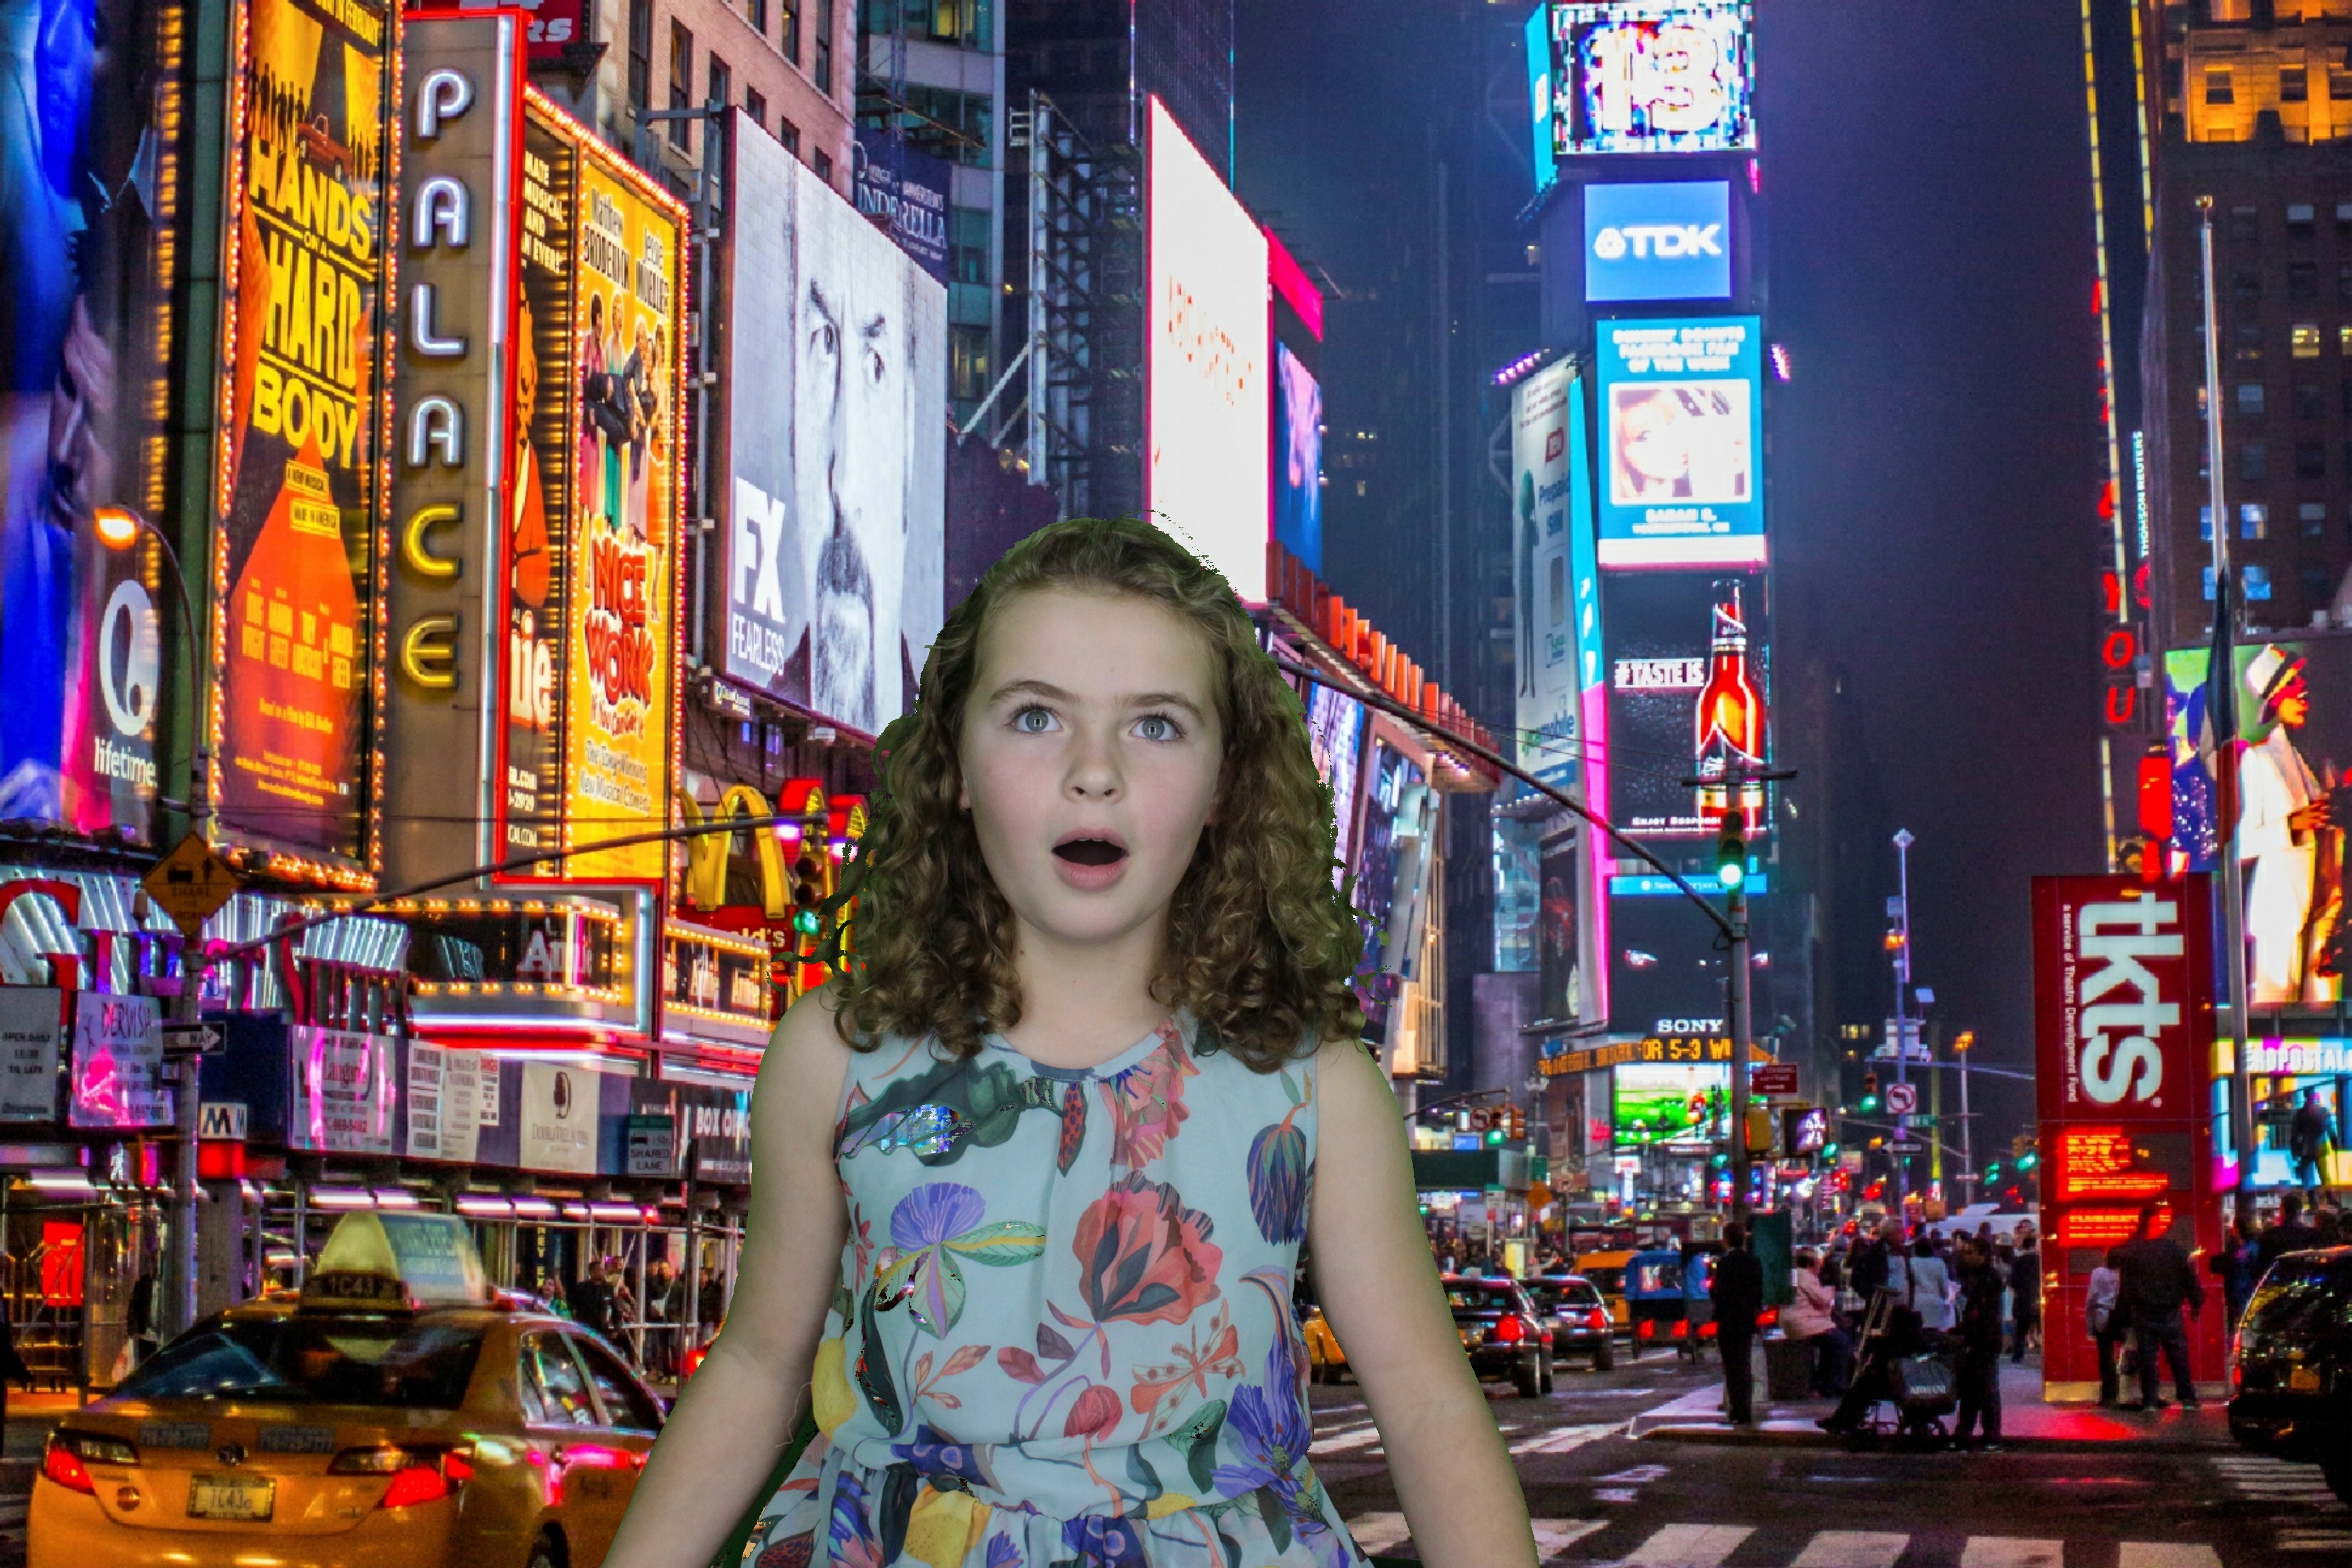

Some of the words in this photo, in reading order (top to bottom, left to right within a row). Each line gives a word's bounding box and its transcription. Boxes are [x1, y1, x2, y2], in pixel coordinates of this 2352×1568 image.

[249, 133, 371, 260] HANDS
[524, 177, 563, 223] MUSICAL
[304, 231, 320, 252] ON
[320, 241, 327, 259] A
[1622, 224, 1722, 258] TDK
[267, 231, 361, 389] HARD
[400, 68, 472, 689] PALACE
[252, 359, 358, 469] BODY
[2132, 431, 2145, 491] REUTERS
[734, 476, 785, 624] FX
[2137, 491, 2149, 559] THOMSON
[593, 536, 646, 627] NICE
[585, 612, 654, 706] WORK
[732, 611, 785, 676] FEARLESS
[1686, 661, 1704, 685] IS
[94, 736, 158, 788] lifetime
[2063, 913, 2076, 950] service
[1657, 1019, 1724, 1032] SONY
[2079, 892, 2185, 1105] tkts
[1669, 1038, 1701, 1060] 5-3
[2064, 1007, 2078, 1074] Development
[2068, 1077, 2079, 1102] Fund
[696, 1105, 720, 1137] BOX
[630, 1148, 670, 1158] SHARED
[636, 1160, 664, 1171] LANE
